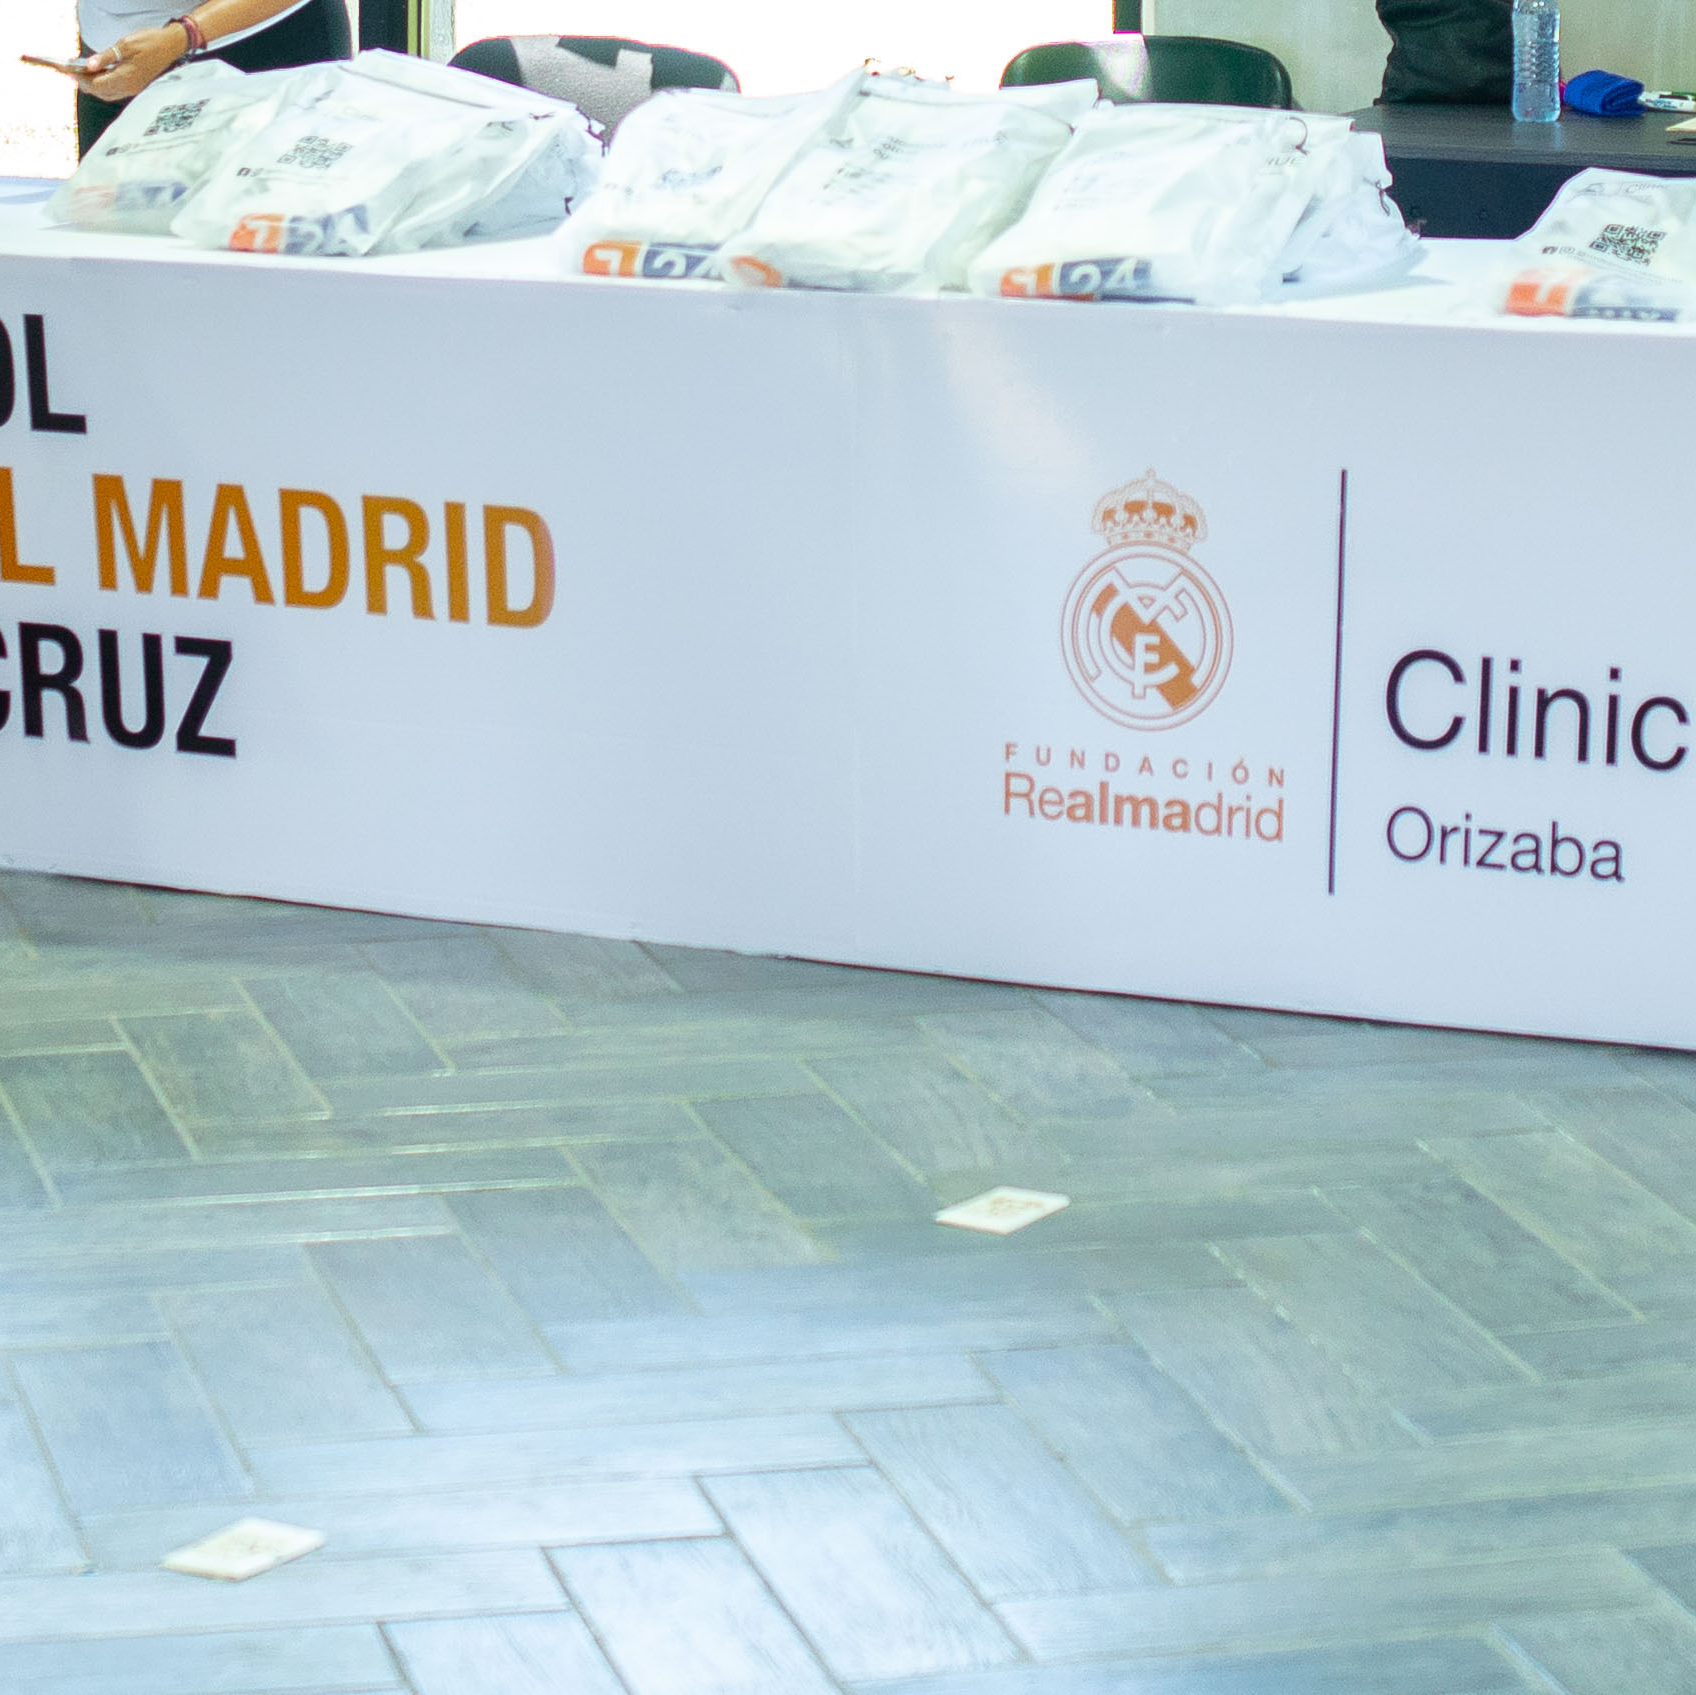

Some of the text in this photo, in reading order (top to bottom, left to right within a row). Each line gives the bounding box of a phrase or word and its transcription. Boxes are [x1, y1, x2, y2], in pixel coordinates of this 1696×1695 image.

[92, 474, 555, 630] MADRID
[1386, 649, 1690, 772] Clinic
[1004, 742, 1286, 787] FUNDACIÓN
[1003, 772, 1286, 842] Realmadrid
[1386, 806, 1625, 883] Orizaba
